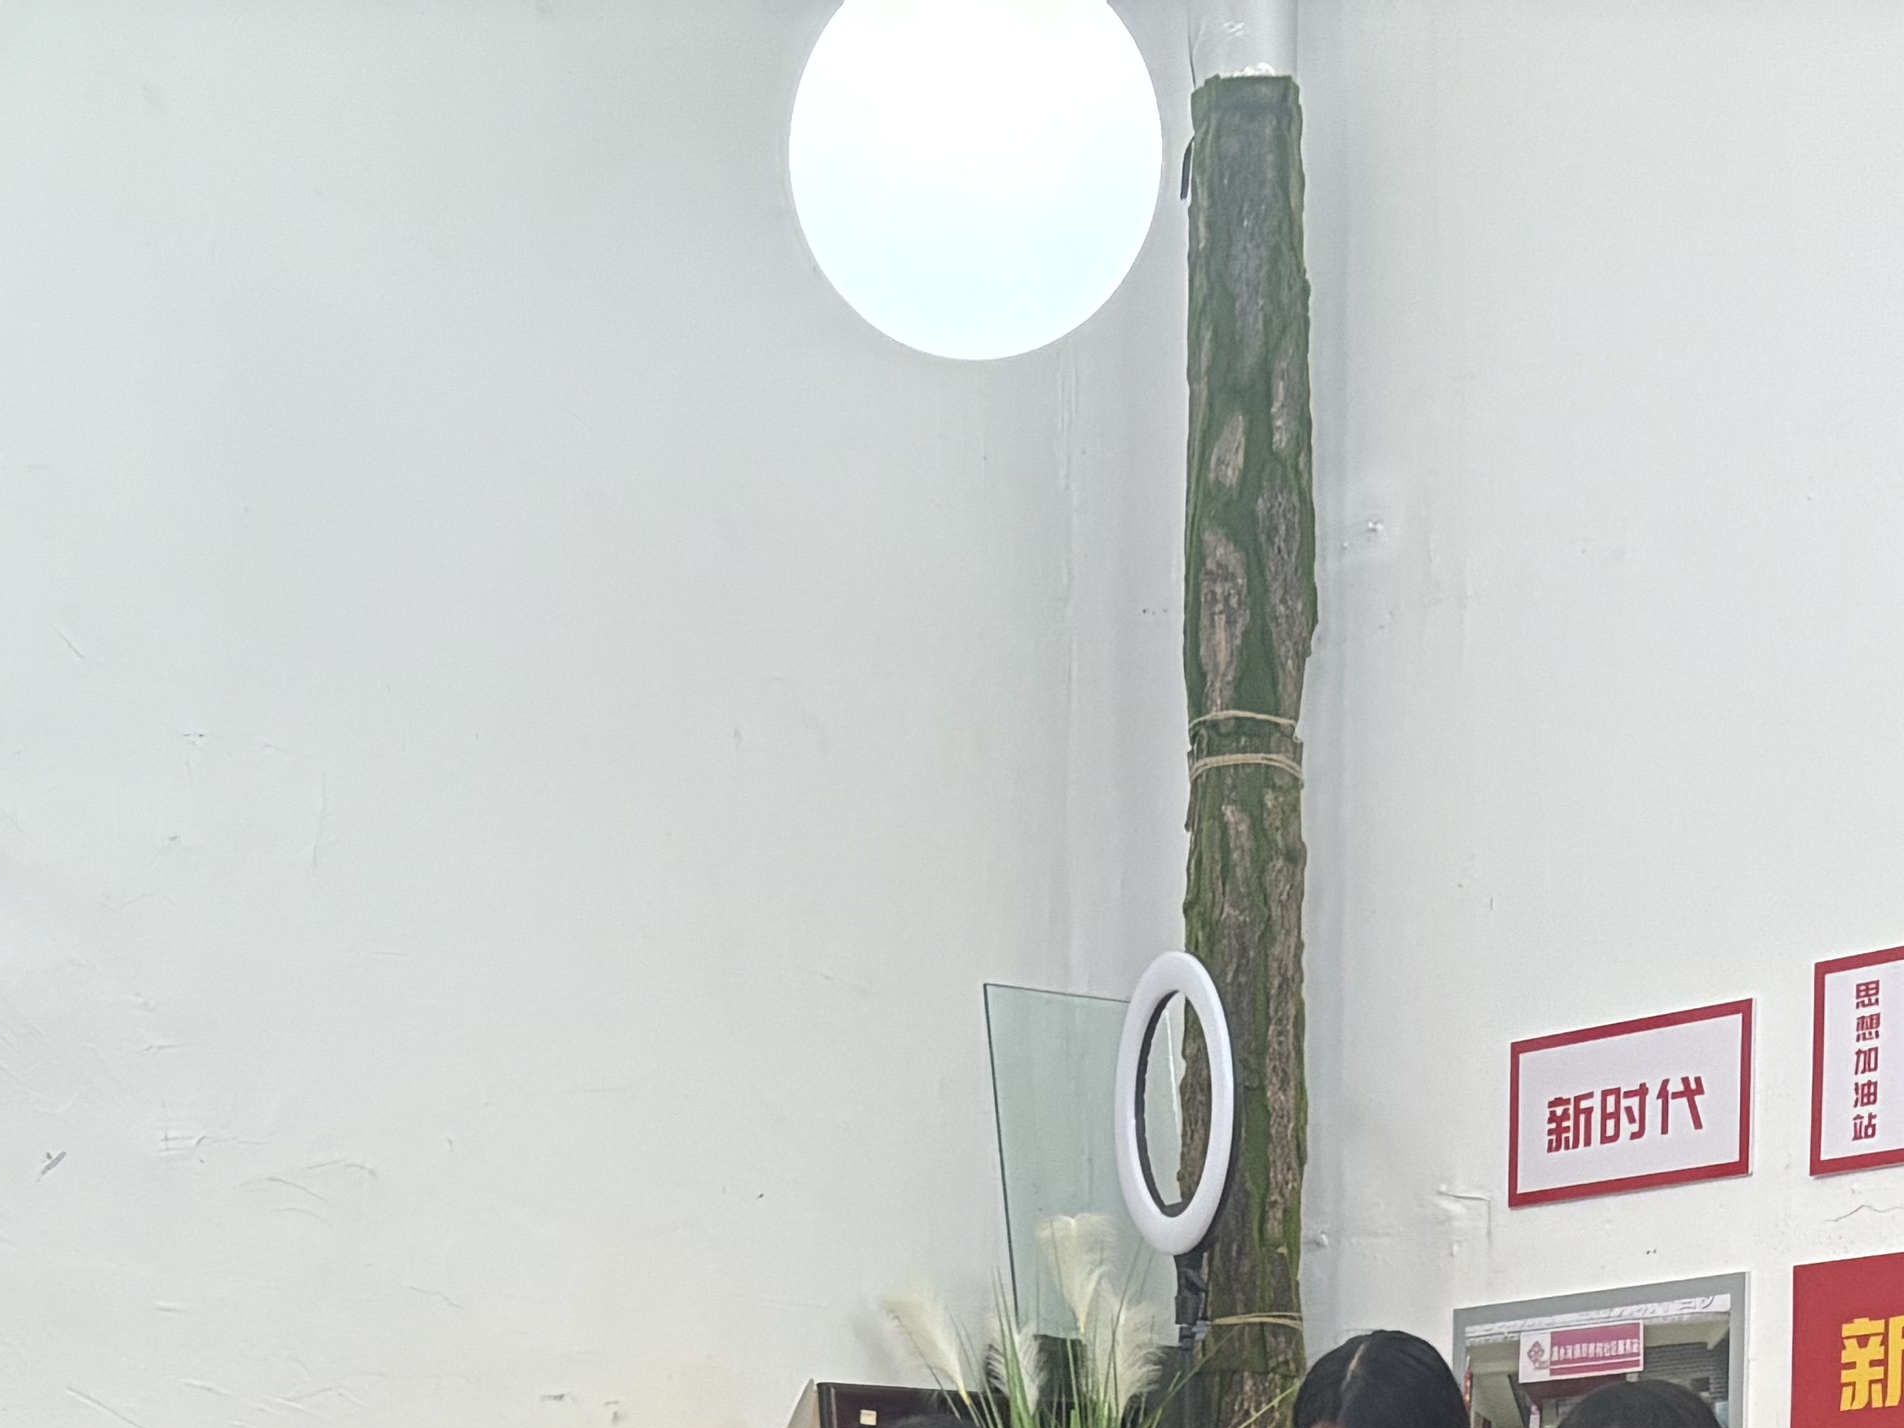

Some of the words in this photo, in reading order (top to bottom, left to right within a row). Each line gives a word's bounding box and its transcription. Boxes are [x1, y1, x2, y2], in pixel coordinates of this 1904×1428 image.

[1546, 1075, 1706, 1154] 新时代
[1851, 979, 1880, 1142] 思想加油站
